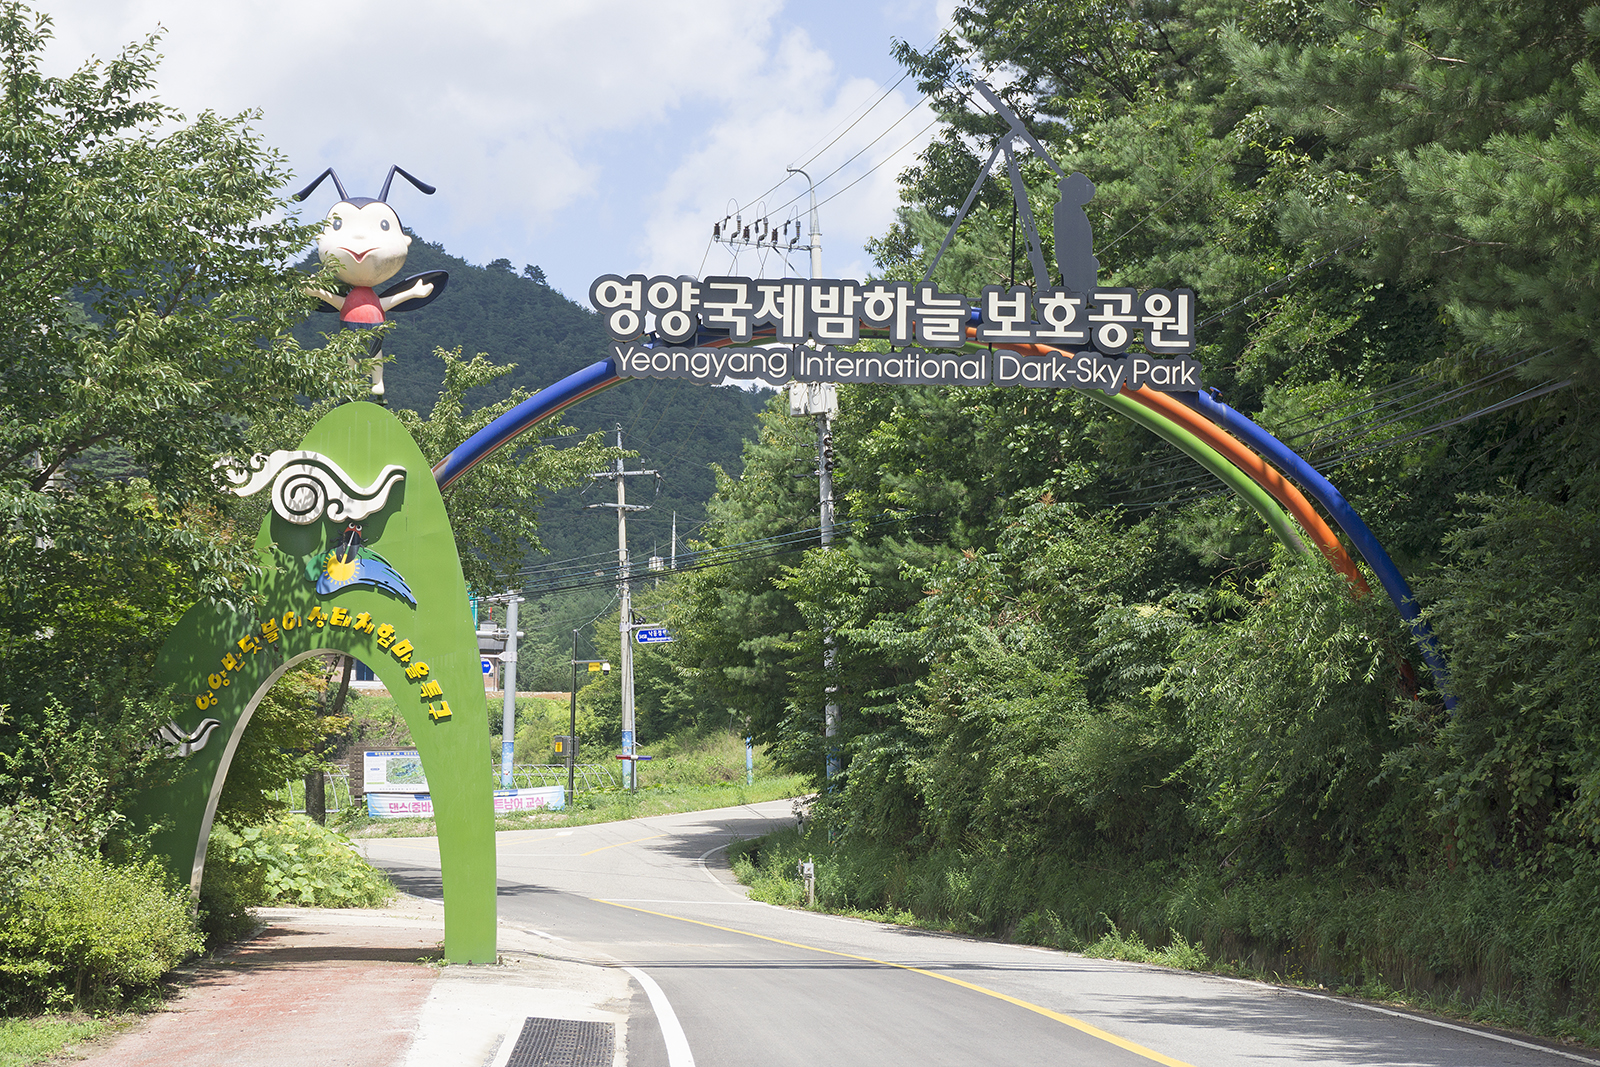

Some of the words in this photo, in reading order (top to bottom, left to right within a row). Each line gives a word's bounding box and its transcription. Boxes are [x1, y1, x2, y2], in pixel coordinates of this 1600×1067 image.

[982, 291, 1190, 348] 보호공원
[614, 346, 788, 378] Yeongyang
[799, 350, 986, 380] International
[999, 355, 1124, 389] Dark-Sky
[1133, 358, 1196, 386] Park
[494, 798, 523, 810] 트남어
